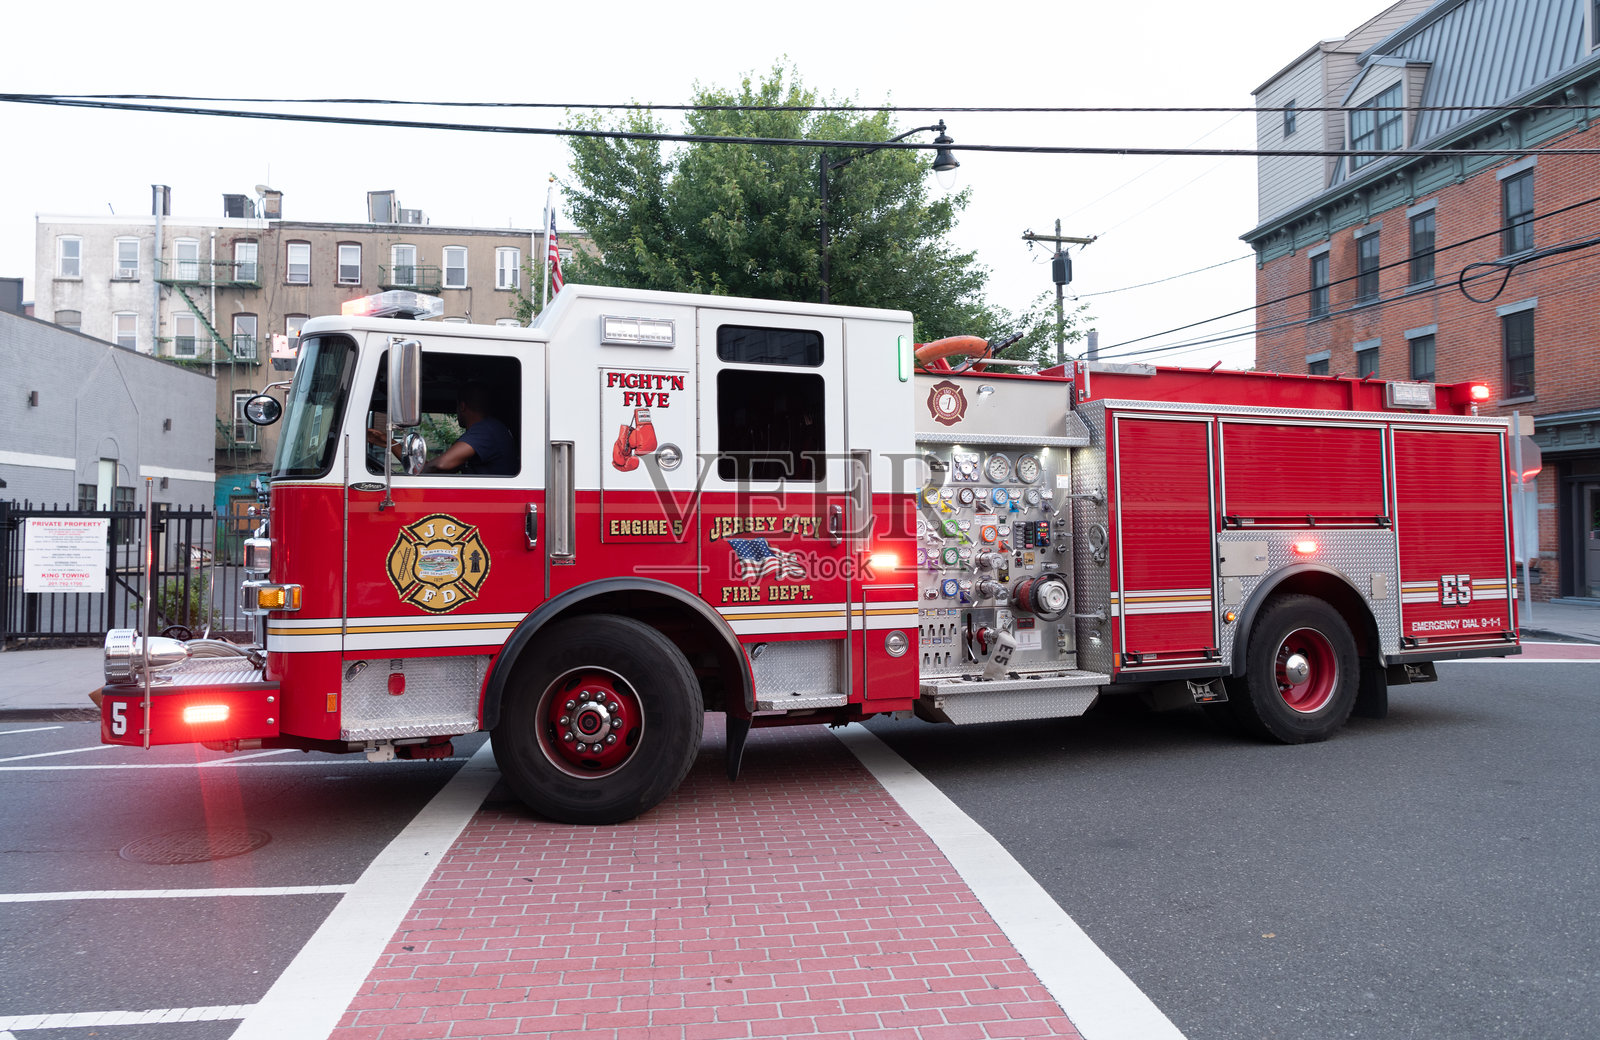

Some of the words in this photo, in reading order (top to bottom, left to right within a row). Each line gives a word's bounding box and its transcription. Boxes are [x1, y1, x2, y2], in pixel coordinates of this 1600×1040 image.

[607, 372, 685, 391] FIGHT'N
[623, 391, 670, 408] FIVE
[609, 519, 668, 537] ENGINE
[672, 519, 683, 536] 5
[709, 516, 777, 543] JERSEY
[782, 516, 822, 541] CITY
[721, 585, 761, 603] FIRE
[768, 584, 814, 601] DEPT.
[1441, 574, 1472, 608] E5
[1412, 619, 1460, 631] EMERGENCY
[1462, 618, 1480, 628] DIAL
[1481, 617, 1501, 627] 9-1-1
[994, 644, 1013, 666] E5
[111, 702, 127, 737] 5
